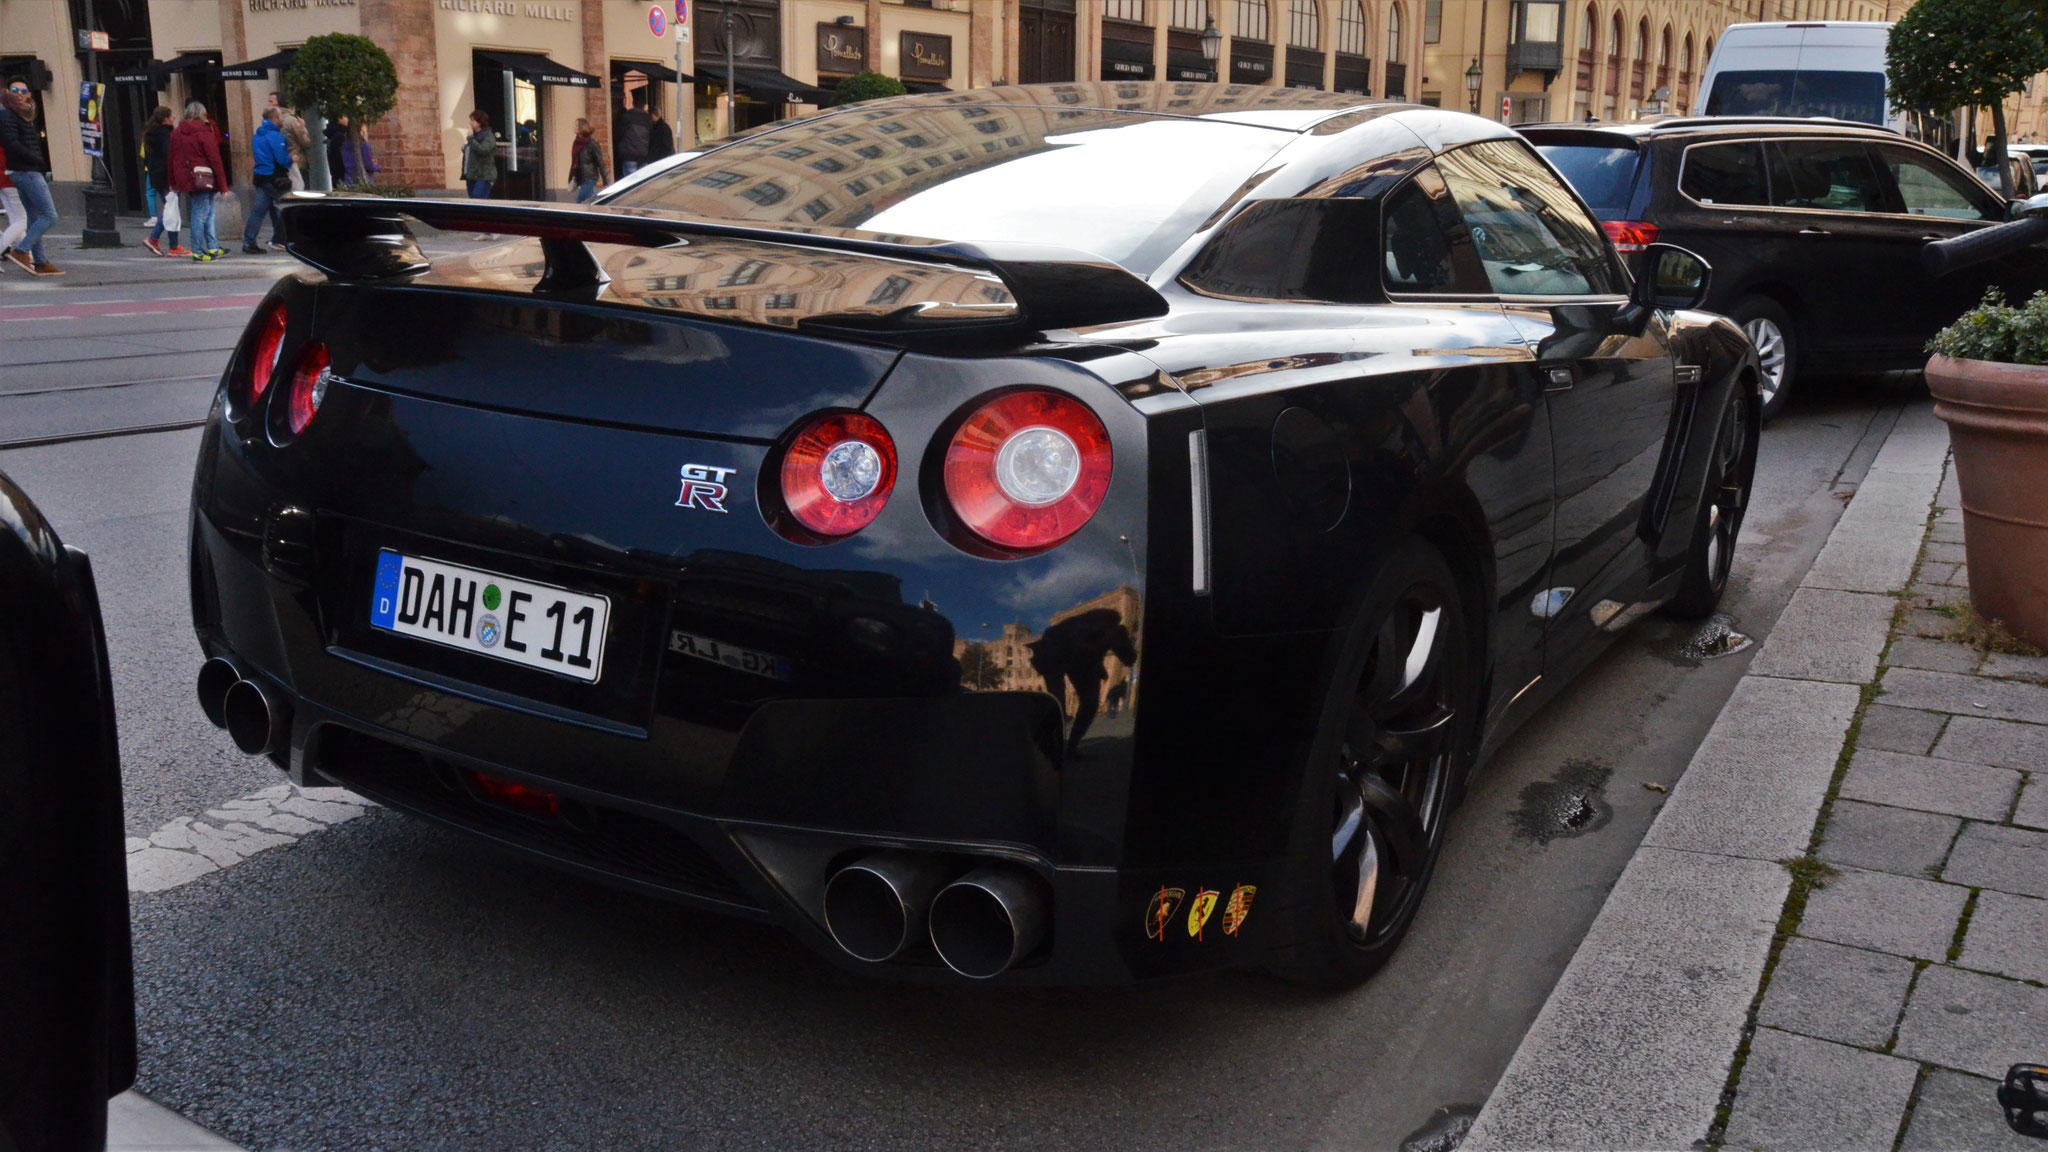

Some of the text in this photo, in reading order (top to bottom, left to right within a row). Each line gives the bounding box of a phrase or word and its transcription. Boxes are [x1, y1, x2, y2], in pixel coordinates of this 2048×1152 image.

[440, 0, 574, 21] RICHARD MILLE
[823, 34, 862, 60] Pomellato
[910, 42, 945, 66] Pomellato
[542, 75, 568, 83] RICHARD
[681, 463, 737, 483] GT
[675, 479, 728, 513] R
[380, 598, 390, 614] D
[398, 566, 595, 669] DAH E 11
